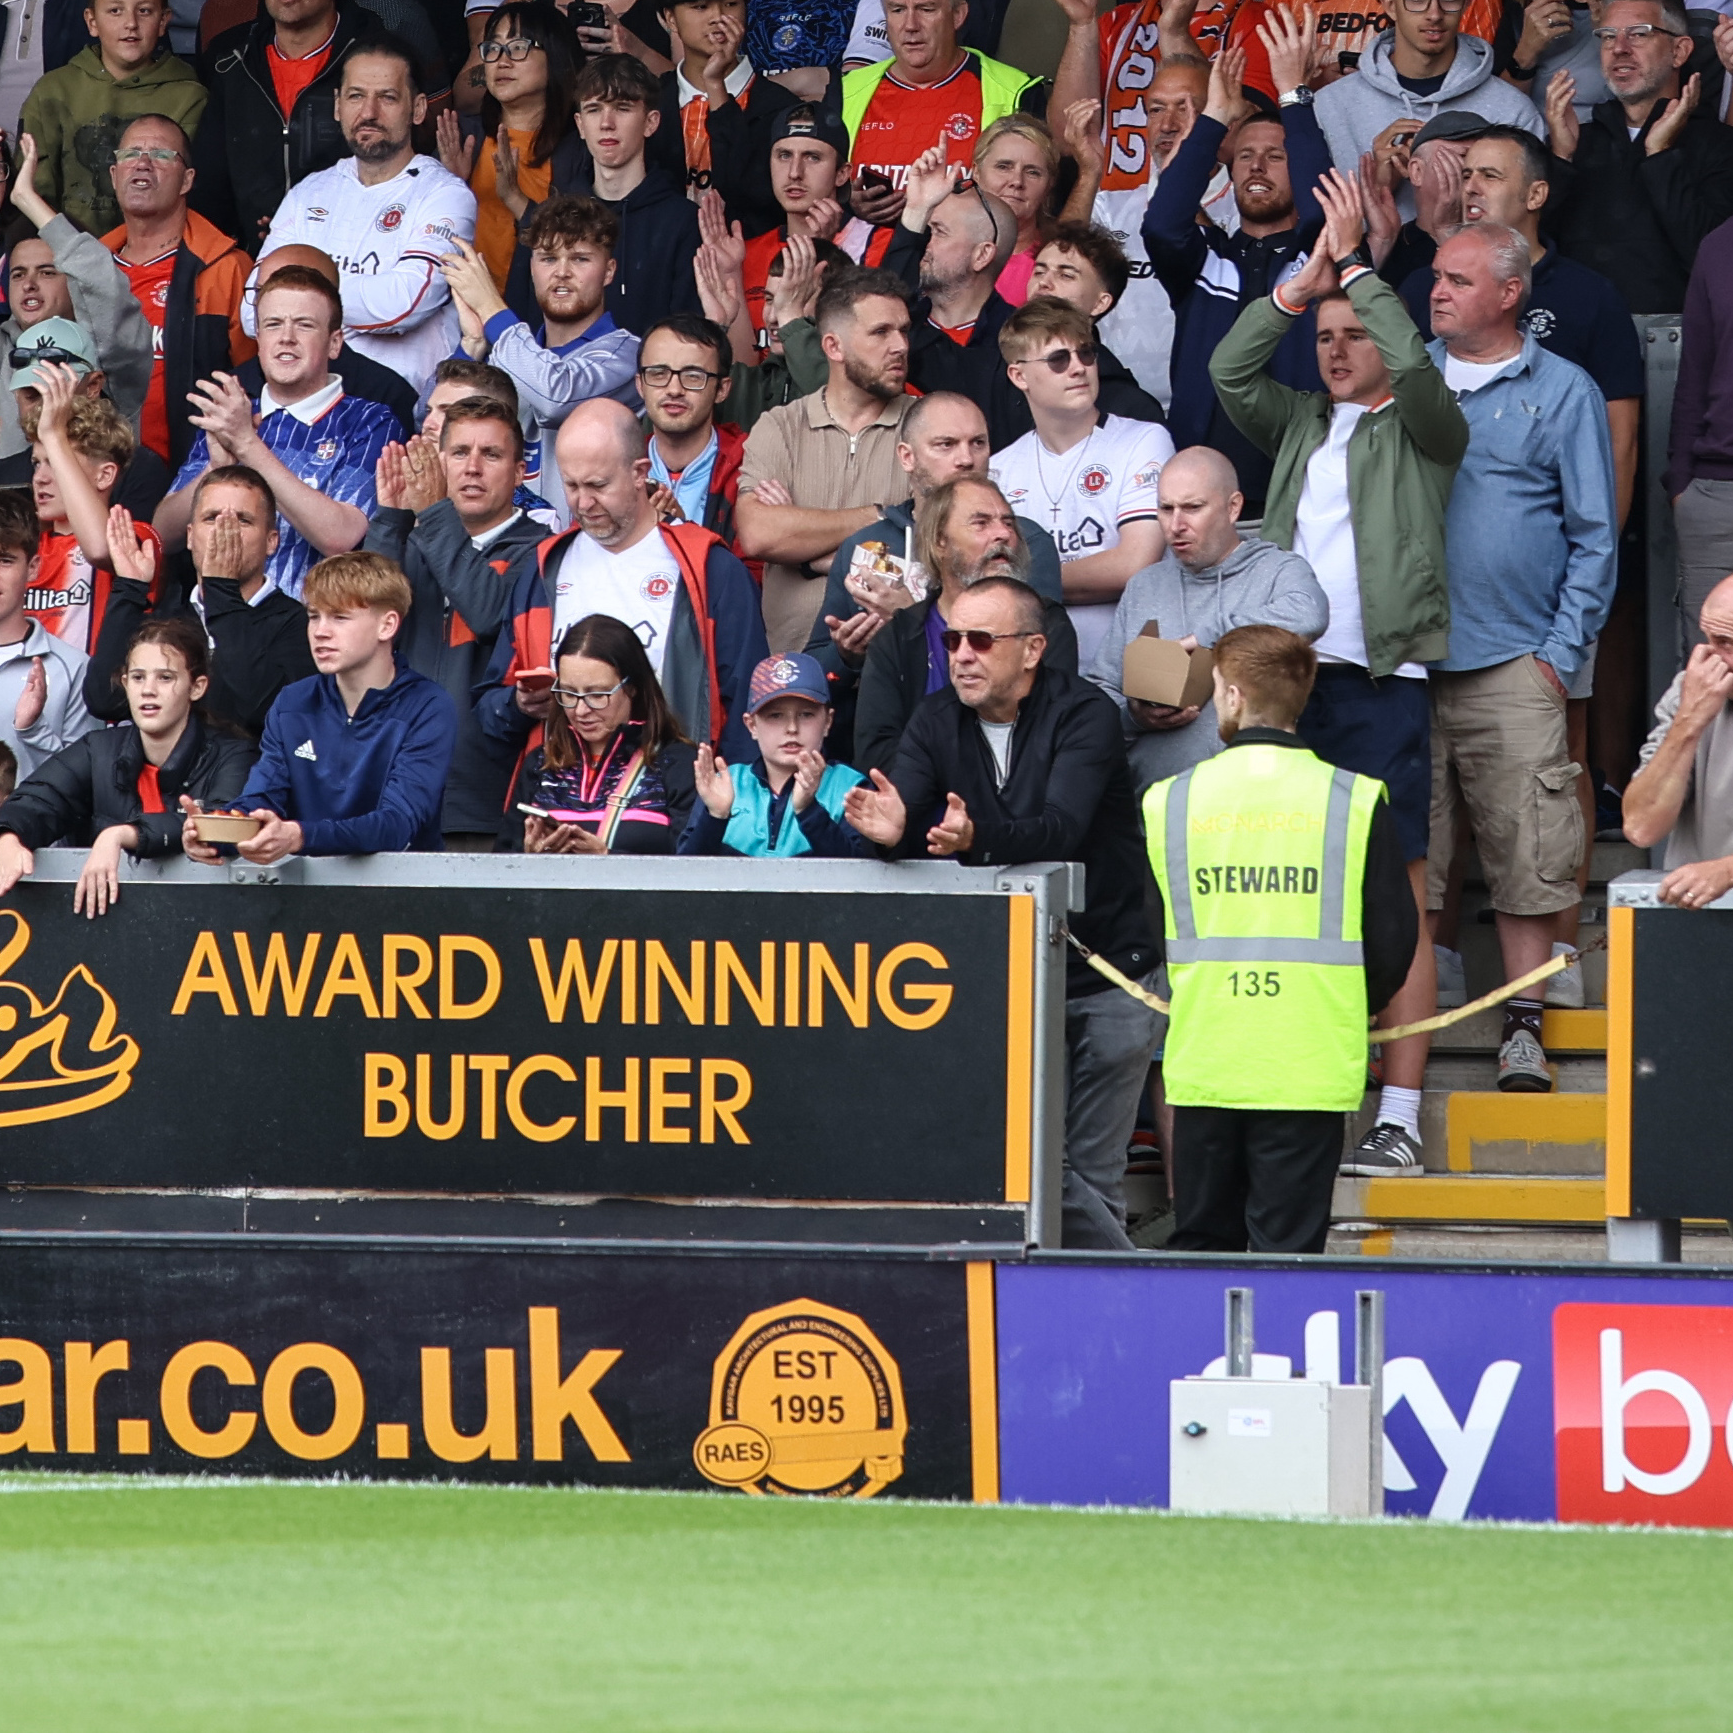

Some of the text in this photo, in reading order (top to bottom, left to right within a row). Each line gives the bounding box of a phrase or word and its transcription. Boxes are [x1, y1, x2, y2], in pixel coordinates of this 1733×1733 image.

[1111, 21, 1160, 175] 2012
[1194, 865, 1318, 896] STEWARD
[171, 931, 955, 1031] AWARD WINNING
[1227, 971, 1281, 997] 135
[363, 1053, 753, 1145] BUTCHER
[773, 1350, 838, 1380] EST
[770, 1394, 845, 1424] 1995
[704, 1441, 764, 1464] RAES
